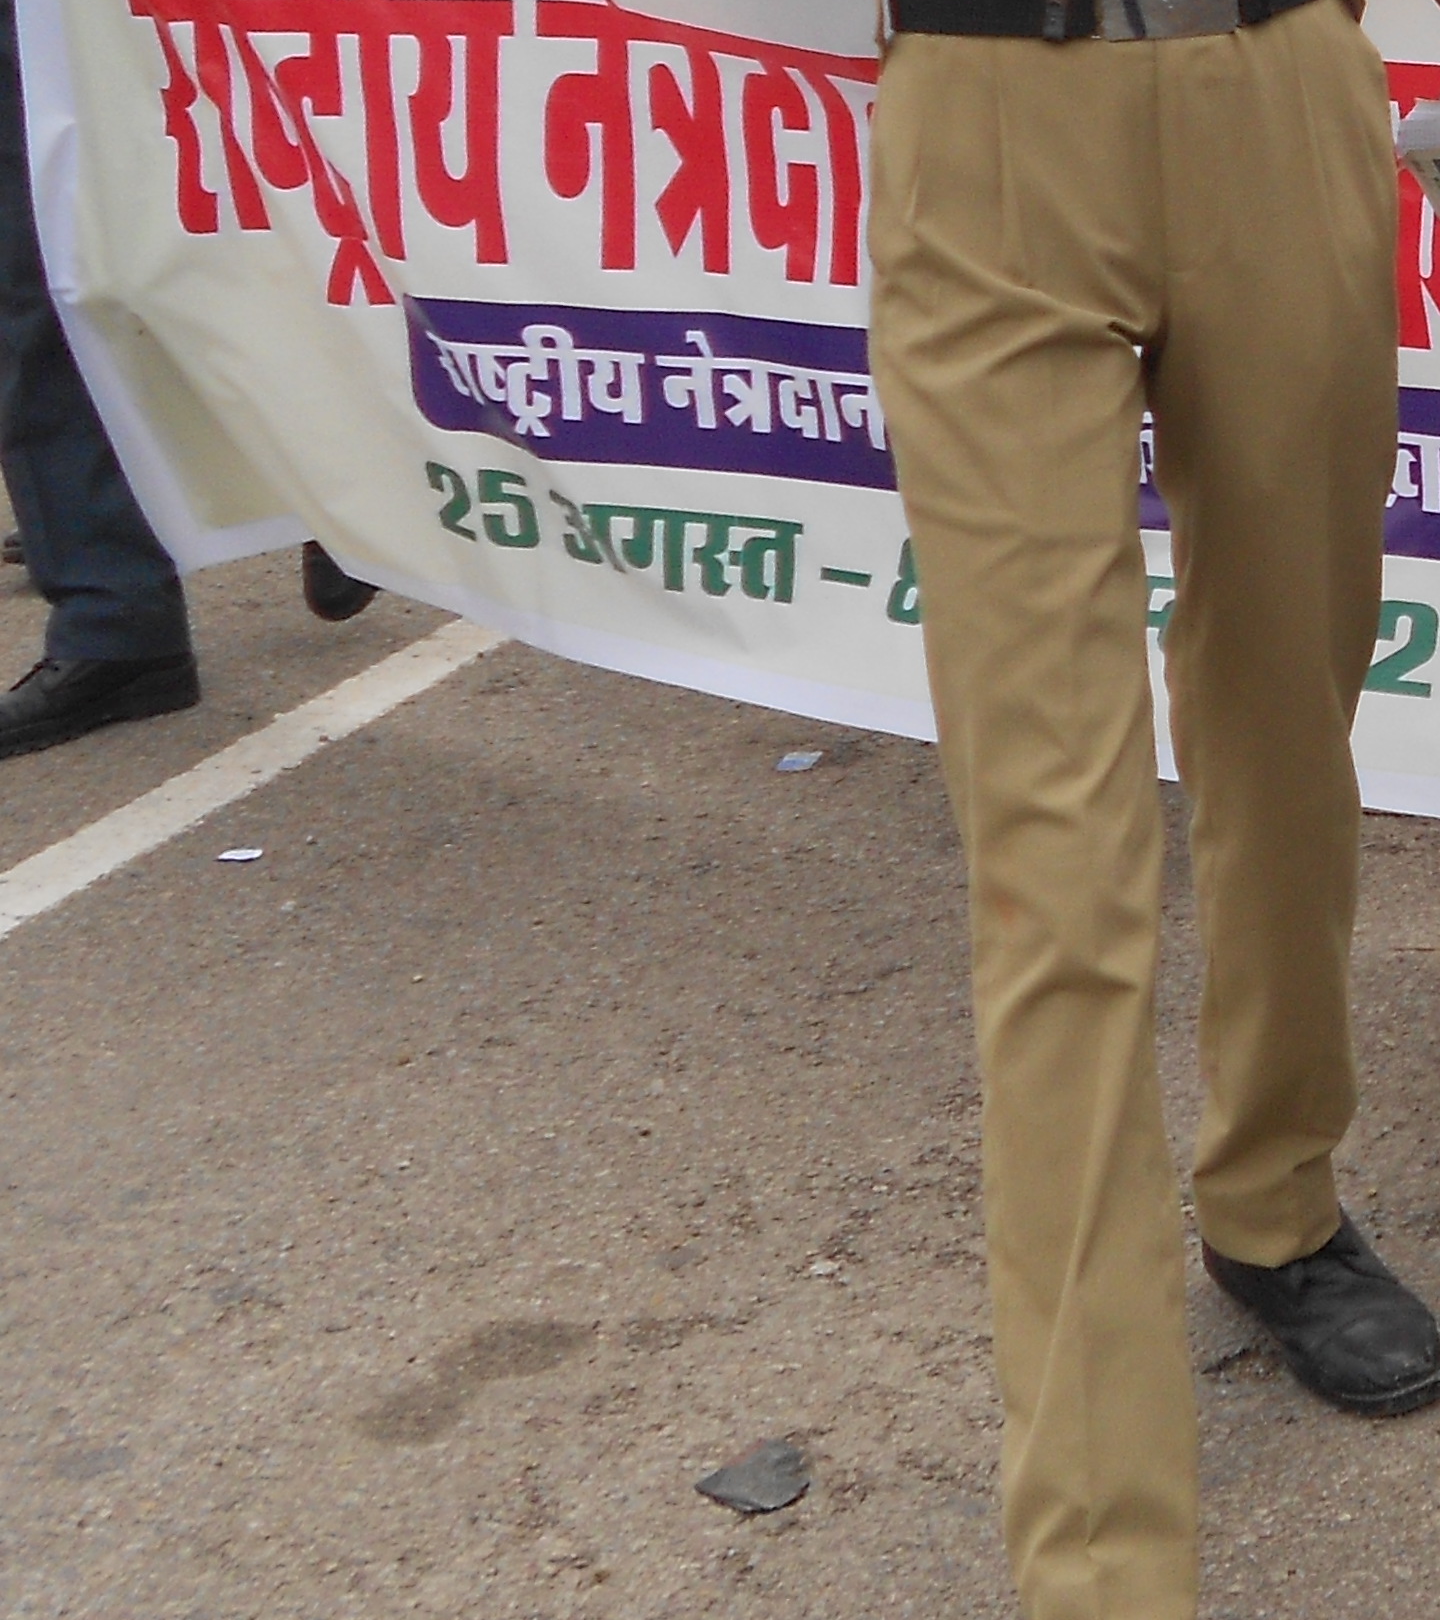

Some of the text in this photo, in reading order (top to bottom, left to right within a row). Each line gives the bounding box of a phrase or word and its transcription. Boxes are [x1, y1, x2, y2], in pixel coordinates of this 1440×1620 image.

[424, 324, 645, 438] राष्ट्रीय
[655, 329, 886, 451] नेत्रदान
[424, 459, 540, 550] 25
[549, 487, 804, 604] अगस्त
